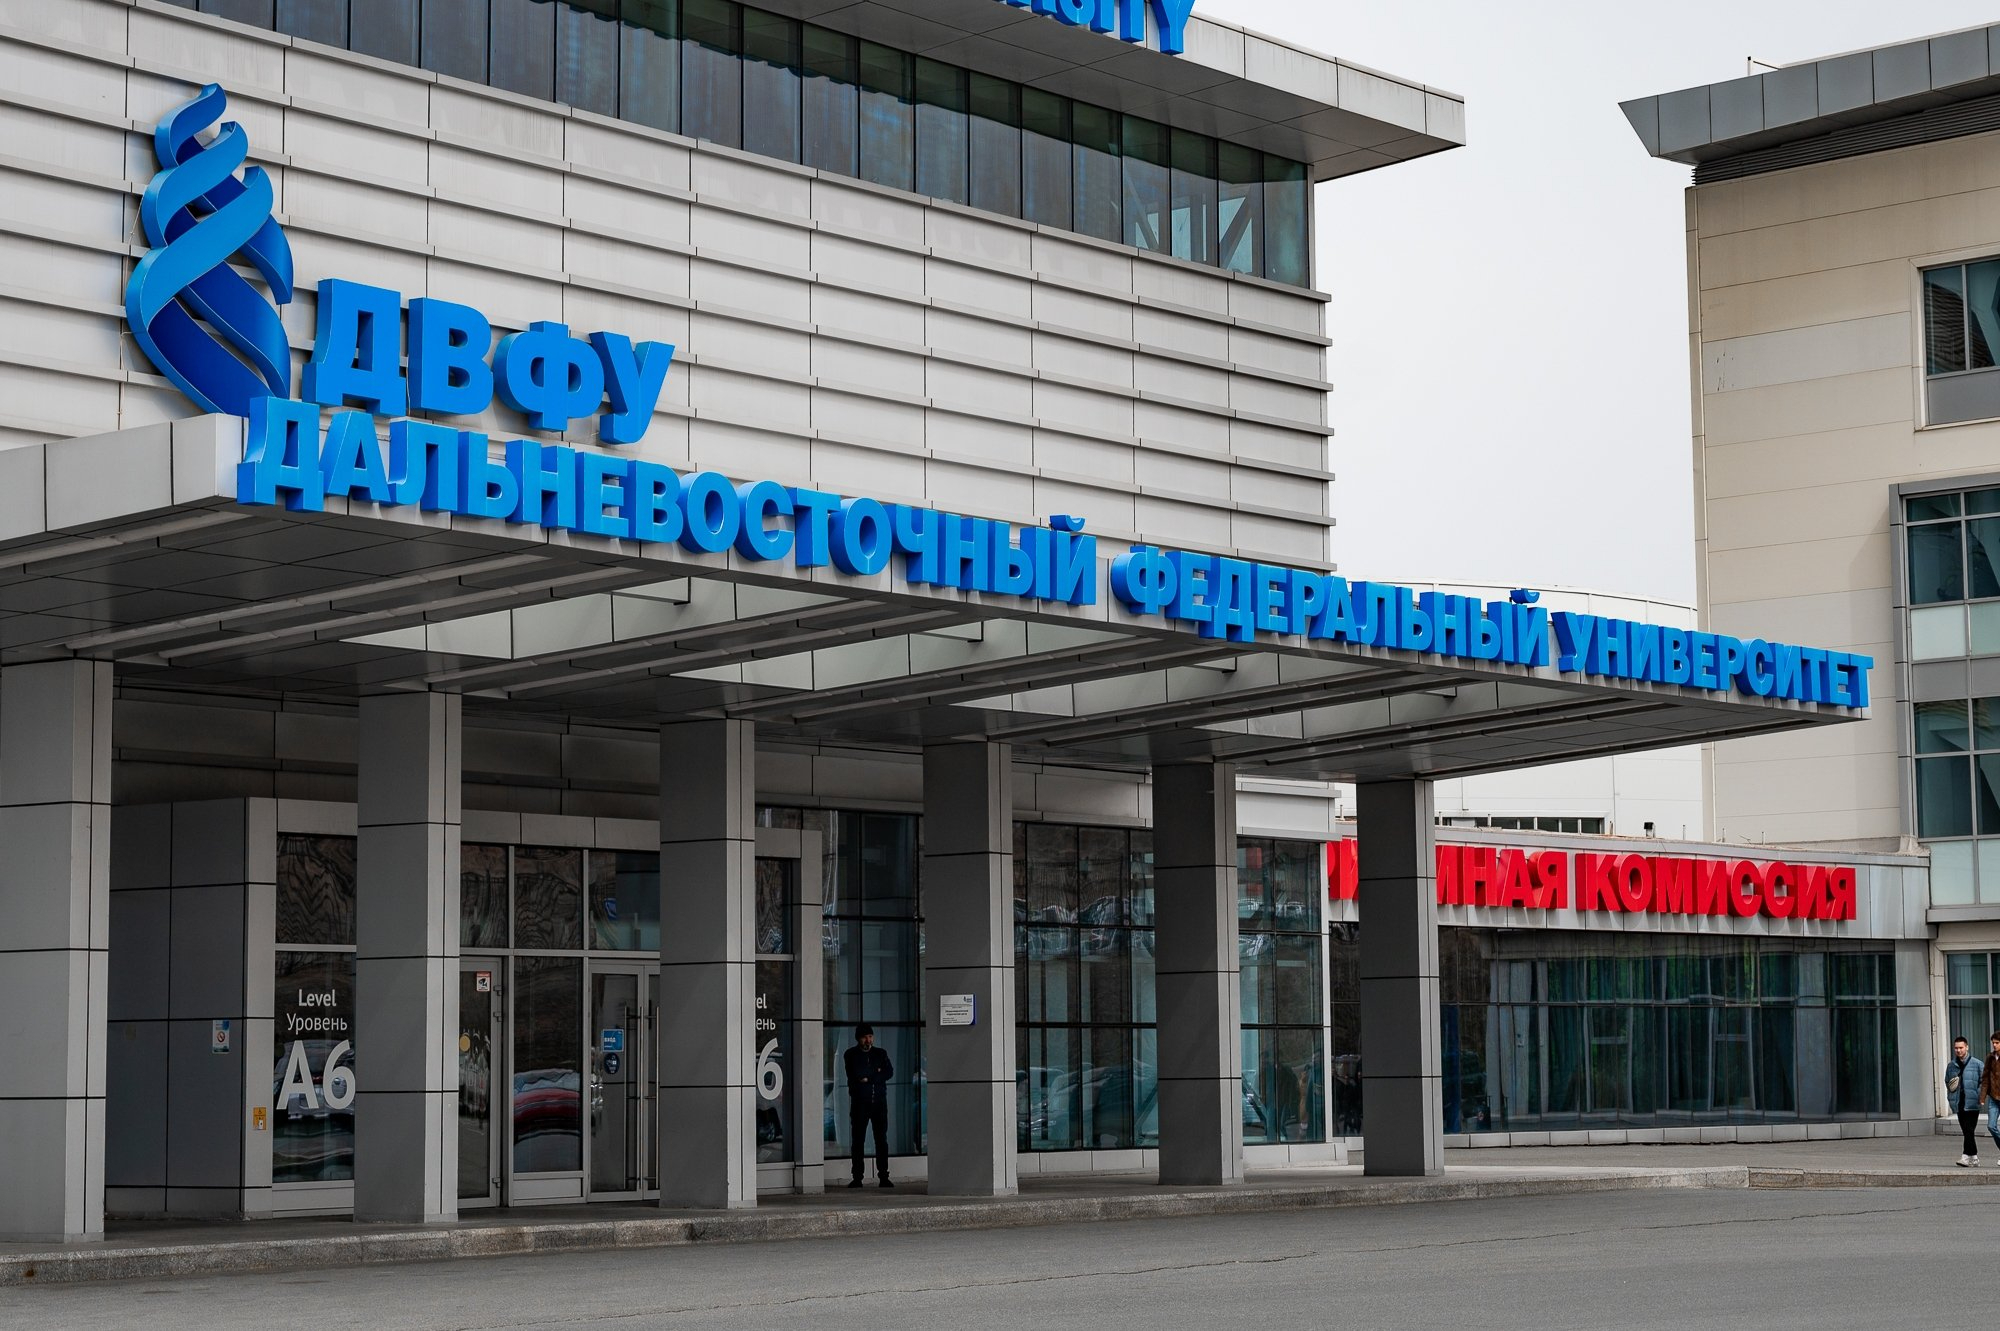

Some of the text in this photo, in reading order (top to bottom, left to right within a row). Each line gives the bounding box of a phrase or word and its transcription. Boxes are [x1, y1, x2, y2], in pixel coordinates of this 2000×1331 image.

[302, 278, 675, 445] ДВФУ
[237, 396, 1874, 709] ДАЛЬНЕВОСТОЧНЫЙ ФЕДЕРАЛЬНЫЙ УНИВЕРСИТЕТ
[1575, 853, 1857, 921] КОМИССИЯ
[286, 1013, 348, 1035] Уровень
[298, 989, 337, 1007] Level
[757, 1037, 784, 1100] 6
